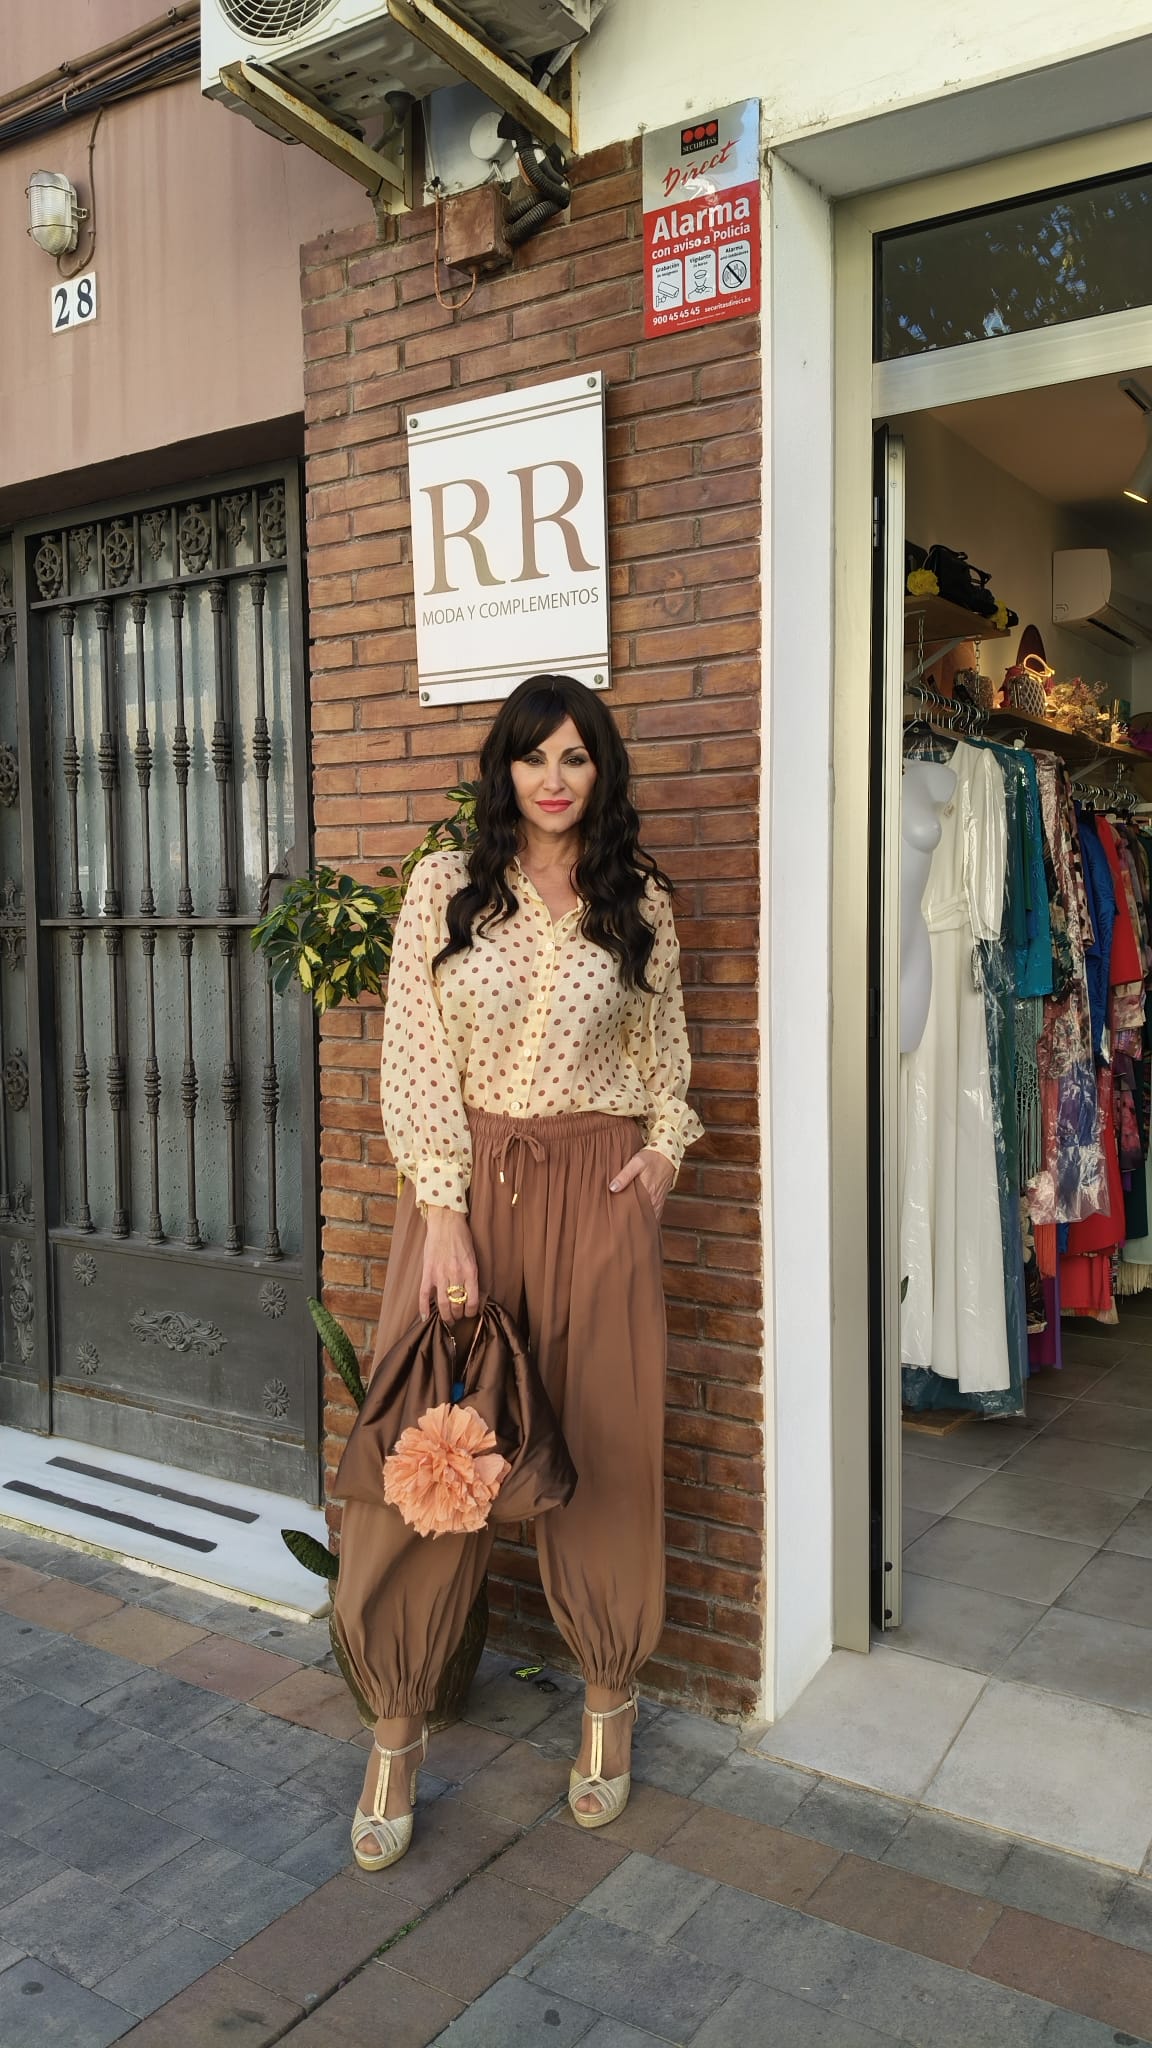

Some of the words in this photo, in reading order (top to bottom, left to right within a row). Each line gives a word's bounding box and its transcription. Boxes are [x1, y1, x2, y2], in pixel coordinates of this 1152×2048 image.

[682, 138, 717, 152] SECURITAS
[662, 138, 741, 196] Direct
[652, 197, 750, 243] Alarma
[652, 247, 671, 260] con
[673, 238, 701, 254] aviso
[703, 235, 710, 245] a
[713, 222, 750, 242] Policía
[55, 279, 93, 328] 28
[653, 315, 667, 326] 900
[669, 312, 678, 321] 45
[679, 309, 689, 319] 45
[690, 306, 700, 316] 45
[419, 461, 600, 595] RR
[423, 607, 464, 627] MODA
[467, 605, 475, 621] Y
[479, 587, 599, 618] COMPLEMENTOS
